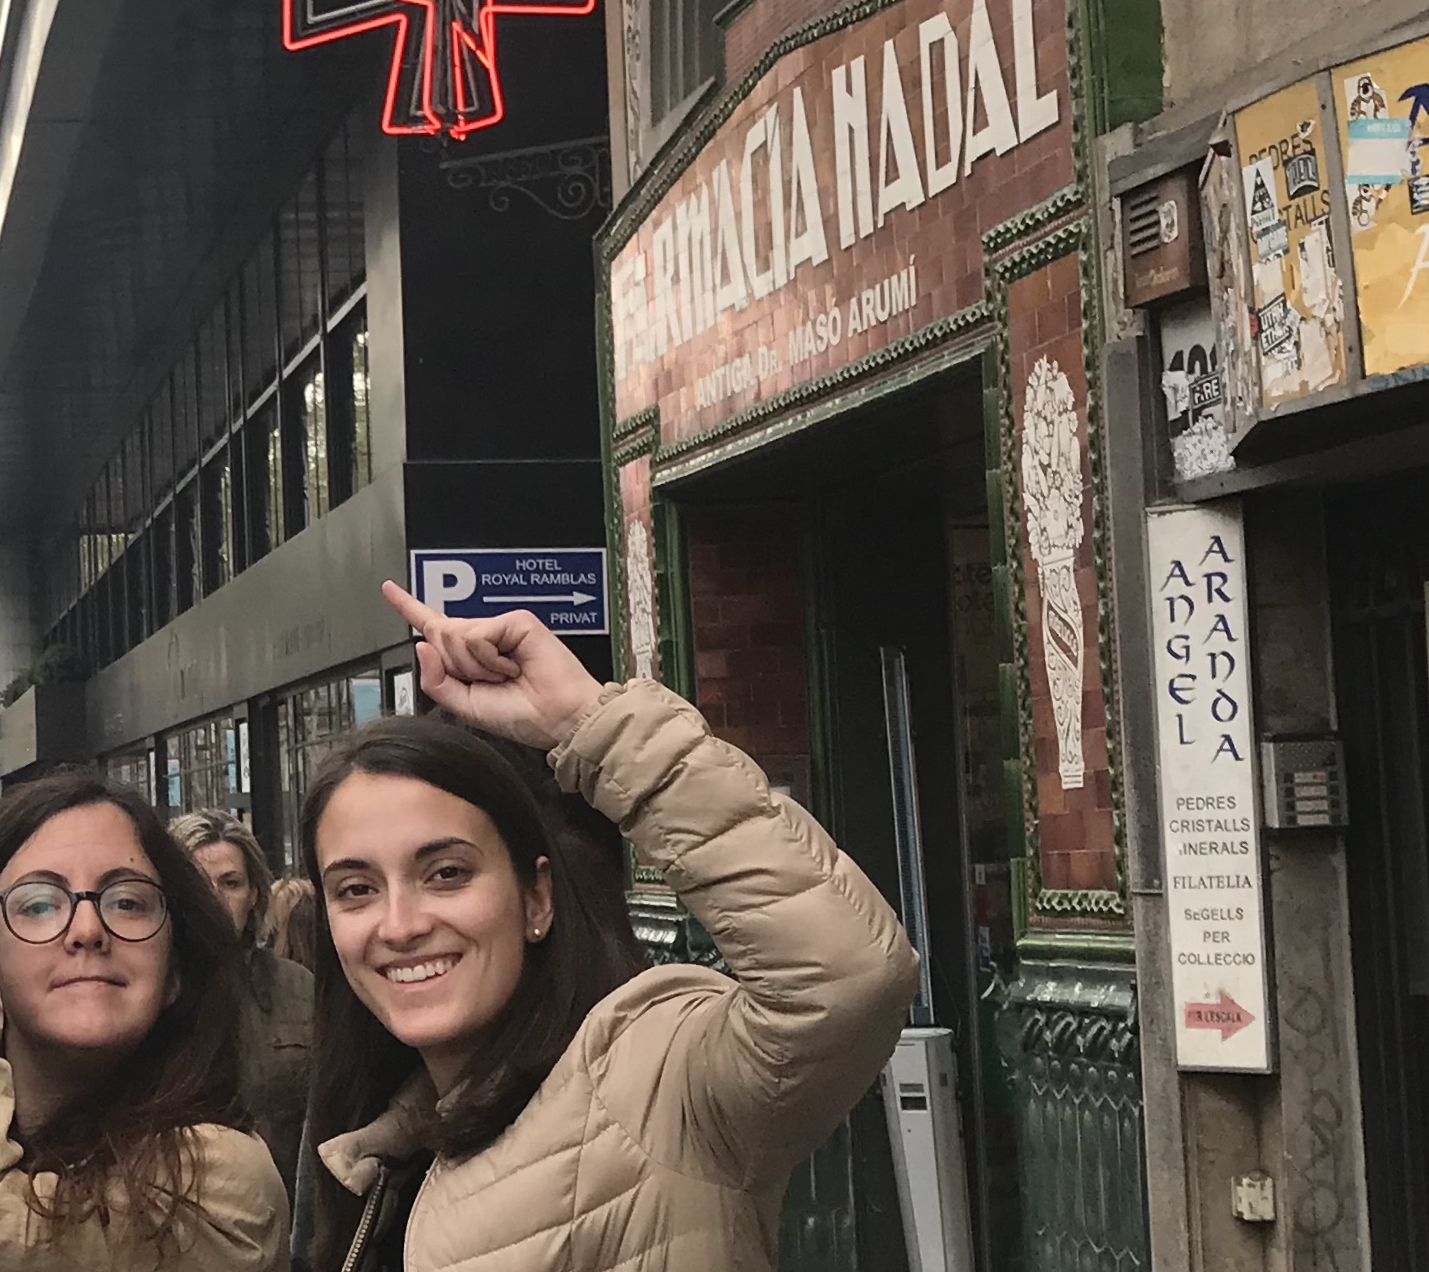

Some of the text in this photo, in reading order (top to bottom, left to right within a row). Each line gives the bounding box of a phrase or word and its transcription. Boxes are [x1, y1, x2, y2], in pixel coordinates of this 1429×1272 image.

[788, 298, 842, 365] MASÓ
[847, 254, 918, 338] ARUMÍ
[515, 559, 562, 571] HOTEL
[481, 573, 597, 586] ROYAL RAMBLAS
[423, 559, 476, 616] P
[550, 612, 598, 625] PRIVAT
[1160, 560, 1198, 746] ANGEL
[1199, 535, 1245, 764] ARANDA
[1176, 796, 1237, 811] PEDRES
[1169, 818, 1250, 834] CRISTALLS
[1179, 841, 1249, 856] INERALS
[1172, 874, 1253, 890] FILATELIA
[1184, 907, 1244, 921] SEGELLS
[1203, 931, 1231, 944] PER
[1177, 952, 1256, 966] COLLECCIO
